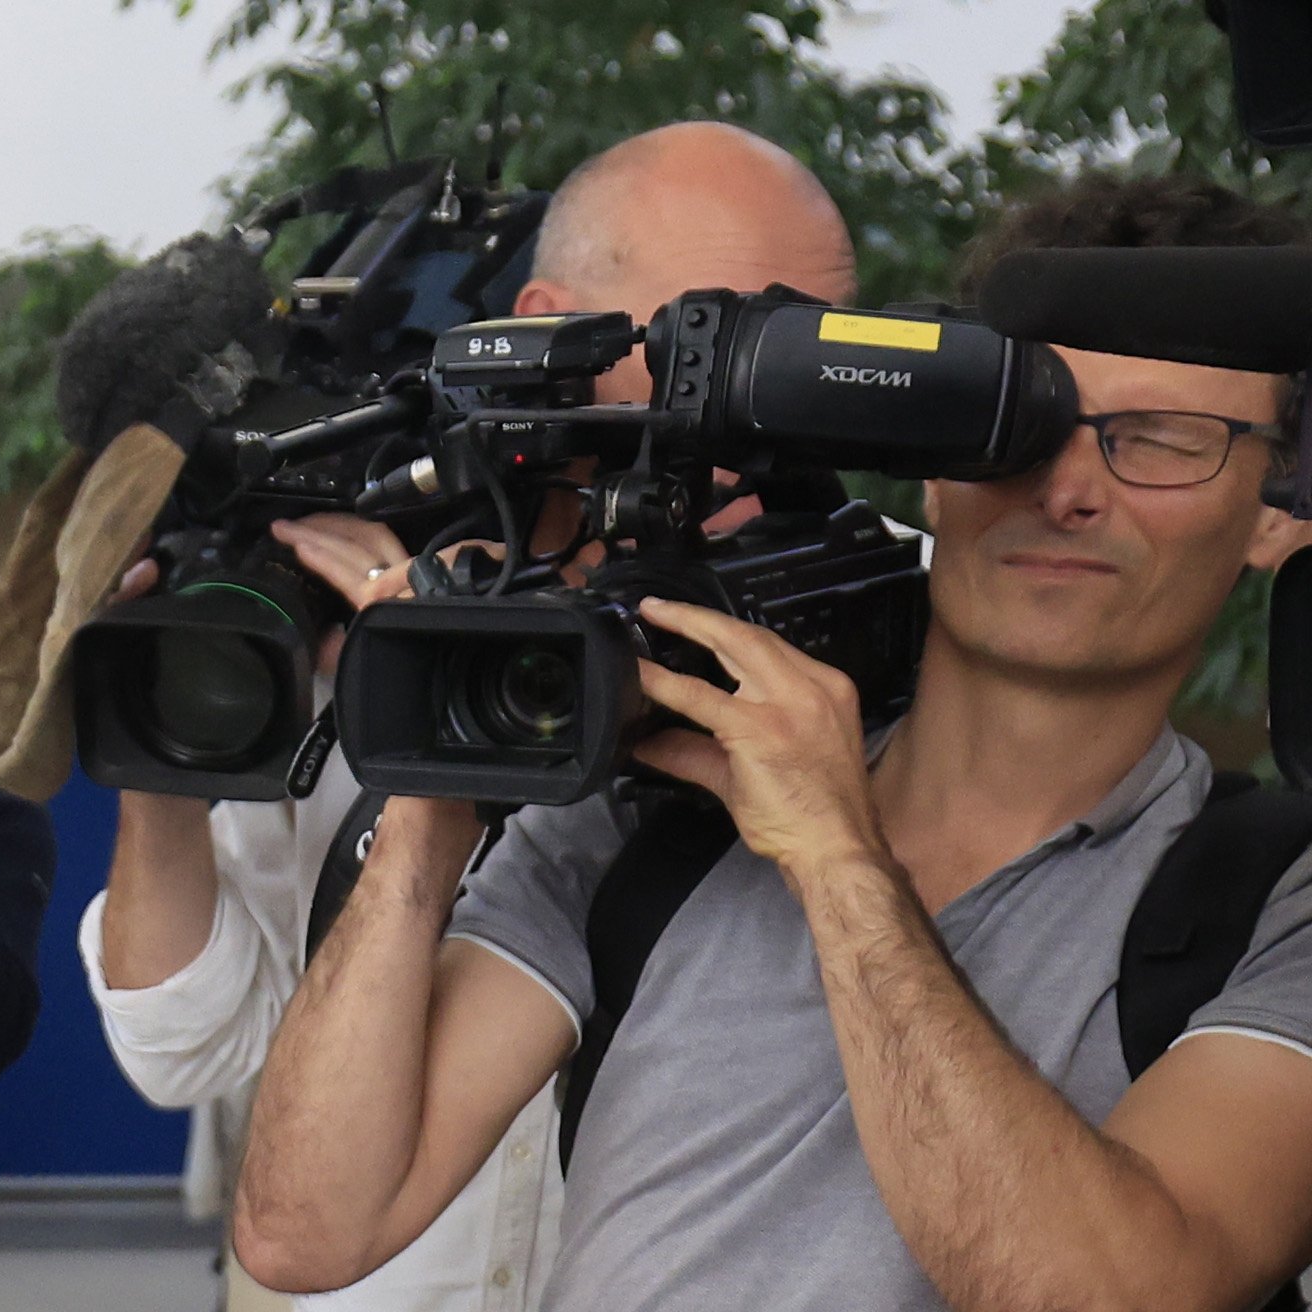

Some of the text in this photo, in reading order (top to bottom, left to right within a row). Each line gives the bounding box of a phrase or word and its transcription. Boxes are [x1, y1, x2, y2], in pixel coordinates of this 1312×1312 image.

[819, 365, 912, 387] XDCAM
[502, 421, 534, 431] SONY
[297, 735, 328, 787] SONY
